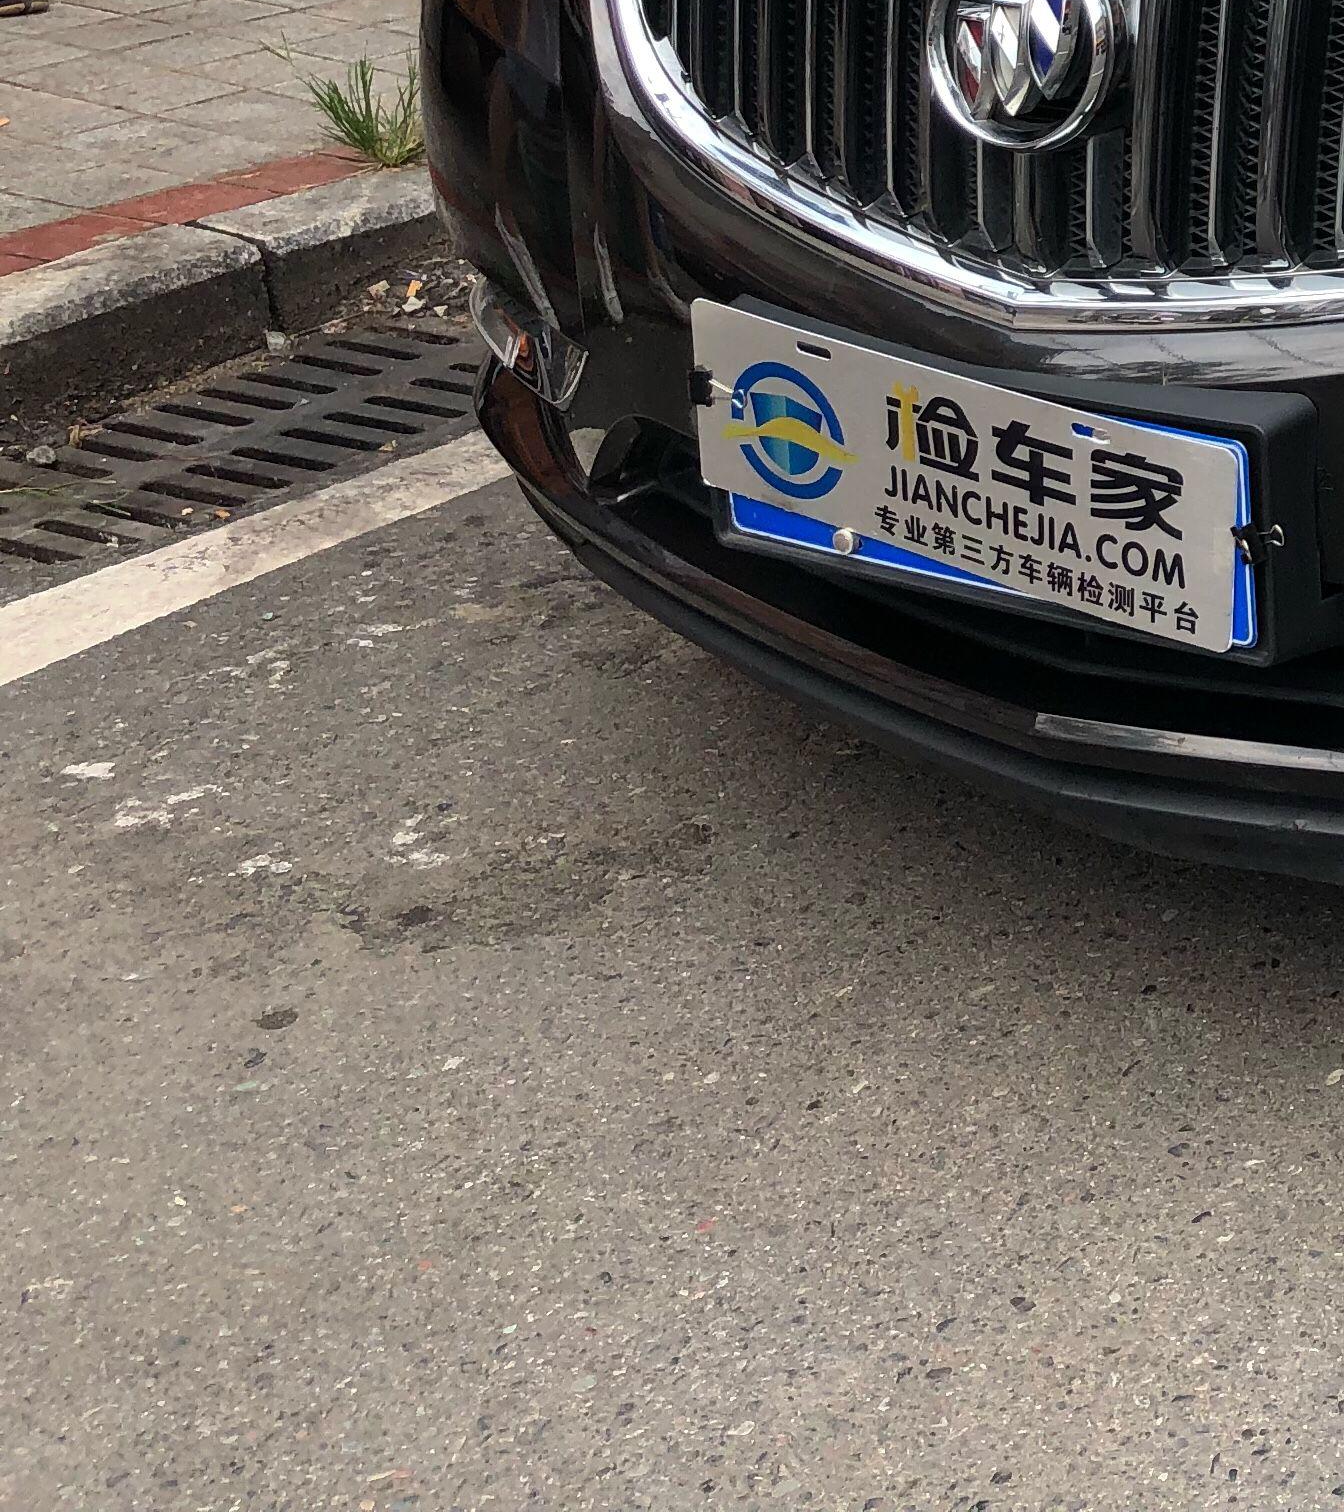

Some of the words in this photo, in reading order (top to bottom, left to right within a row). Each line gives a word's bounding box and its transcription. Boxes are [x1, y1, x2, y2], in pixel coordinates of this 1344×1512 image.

[884, 380, 1184, 541] 检车家
[874, 504, 1199, 635] 专业第三方车辆检测平台
[883, 465, 1187, 590] JIANCHEJIA.COM
